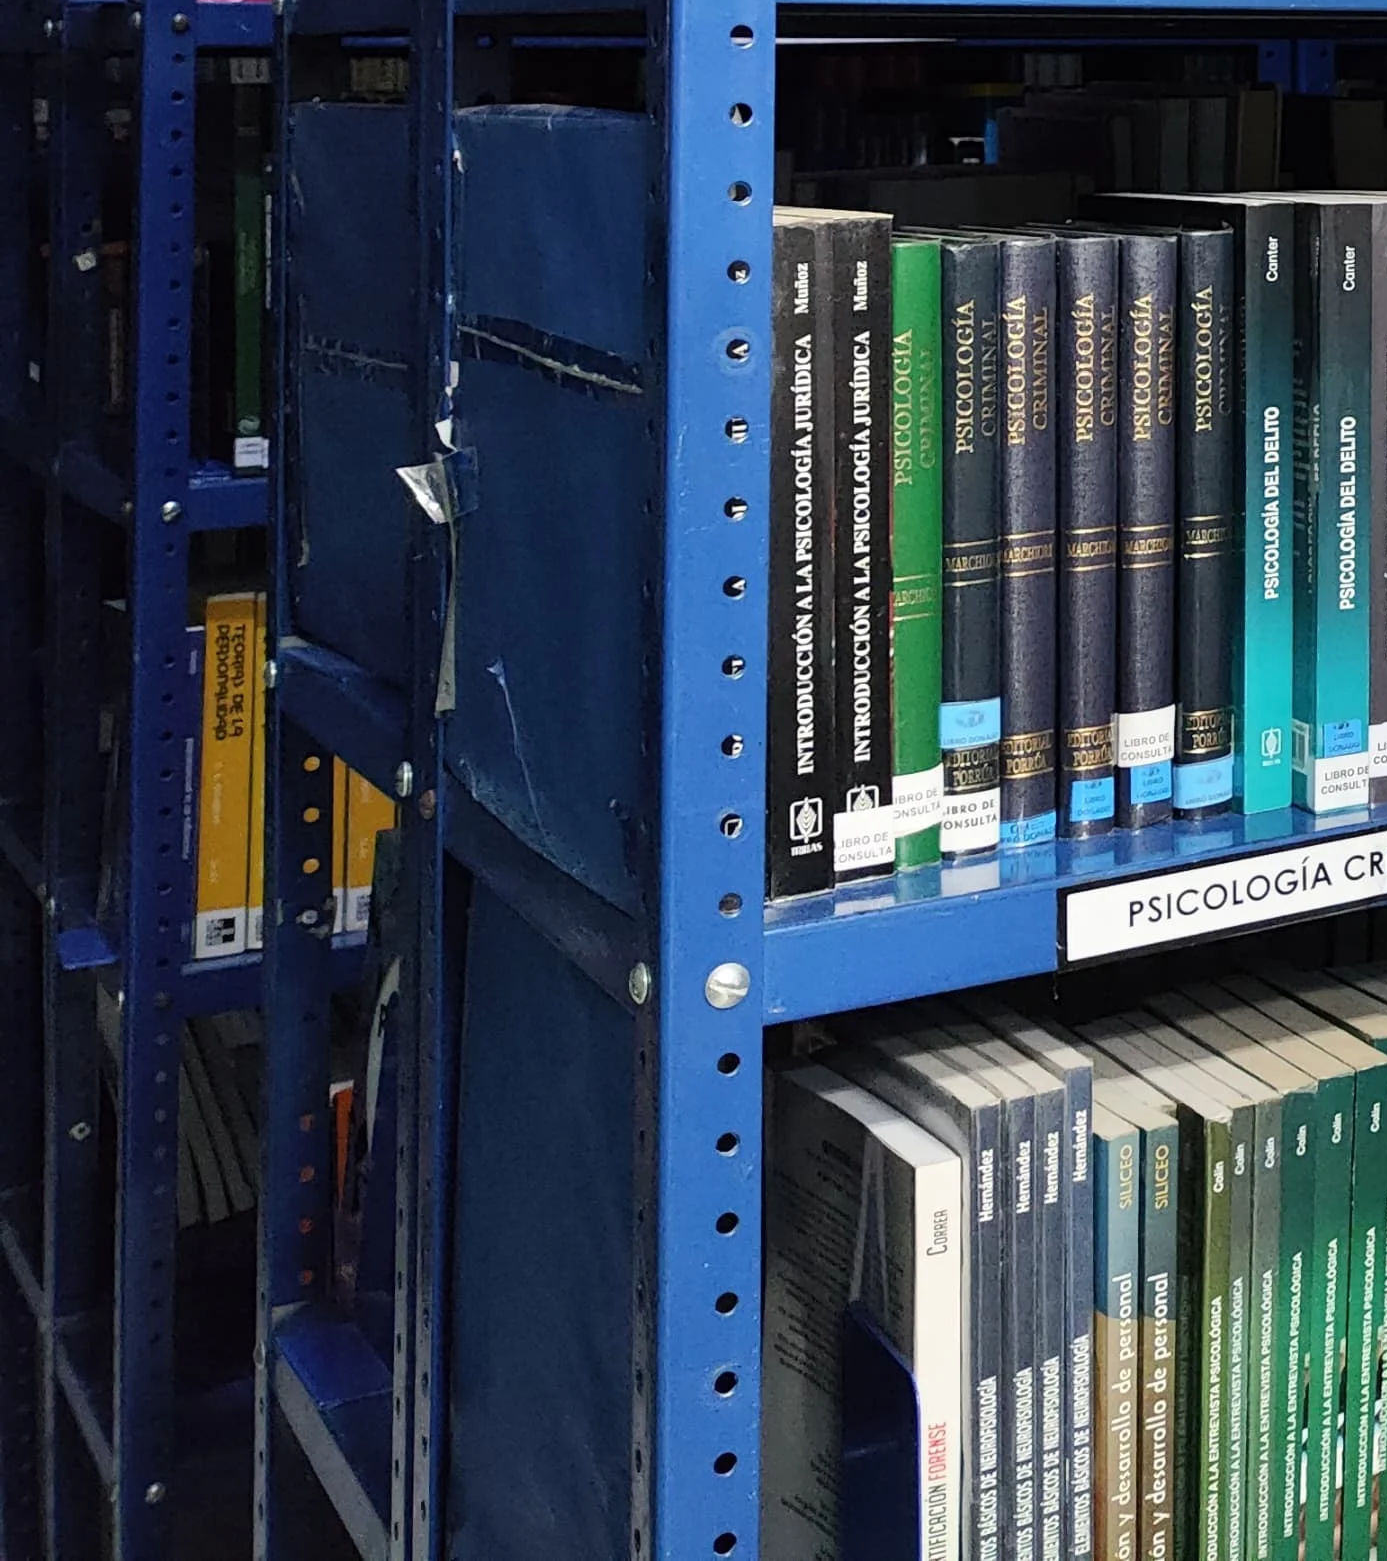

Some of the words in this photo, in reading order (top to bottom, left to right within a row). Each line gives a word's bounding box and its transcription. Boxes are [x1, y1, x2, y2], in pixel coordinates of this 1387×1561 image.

[794, 263, 809, 316] Muñoz
[1266, 236, 1279, 282] Canter
[792, 334, 814, 431] JURÍDICA
[1071, 293, 1095, 444] PSICOLOGÍA
[1100, 305, 1115, 426] CRIMINAL
[1264, 406, 1280, 463] DELITO
[792, 436, 813, 561] PSICOLOGÍA
[1264, 466, 1280, 497] DEL
[798, 564, 814, 593] LA
[1261, 500, 1280, 600] PSICOLOGÍA
[798, 596, 814, 612] A
[794, 615, 815, 776] INTRODUCCIÓN
[1128, 858, 1332, 927] PSICOLOGÍA
[978, 1149, 993, 1223] Hernández
[1119, 1144, 1133, 1209] SILICEO
[929, 1422, 949, 1482] FORENSE
